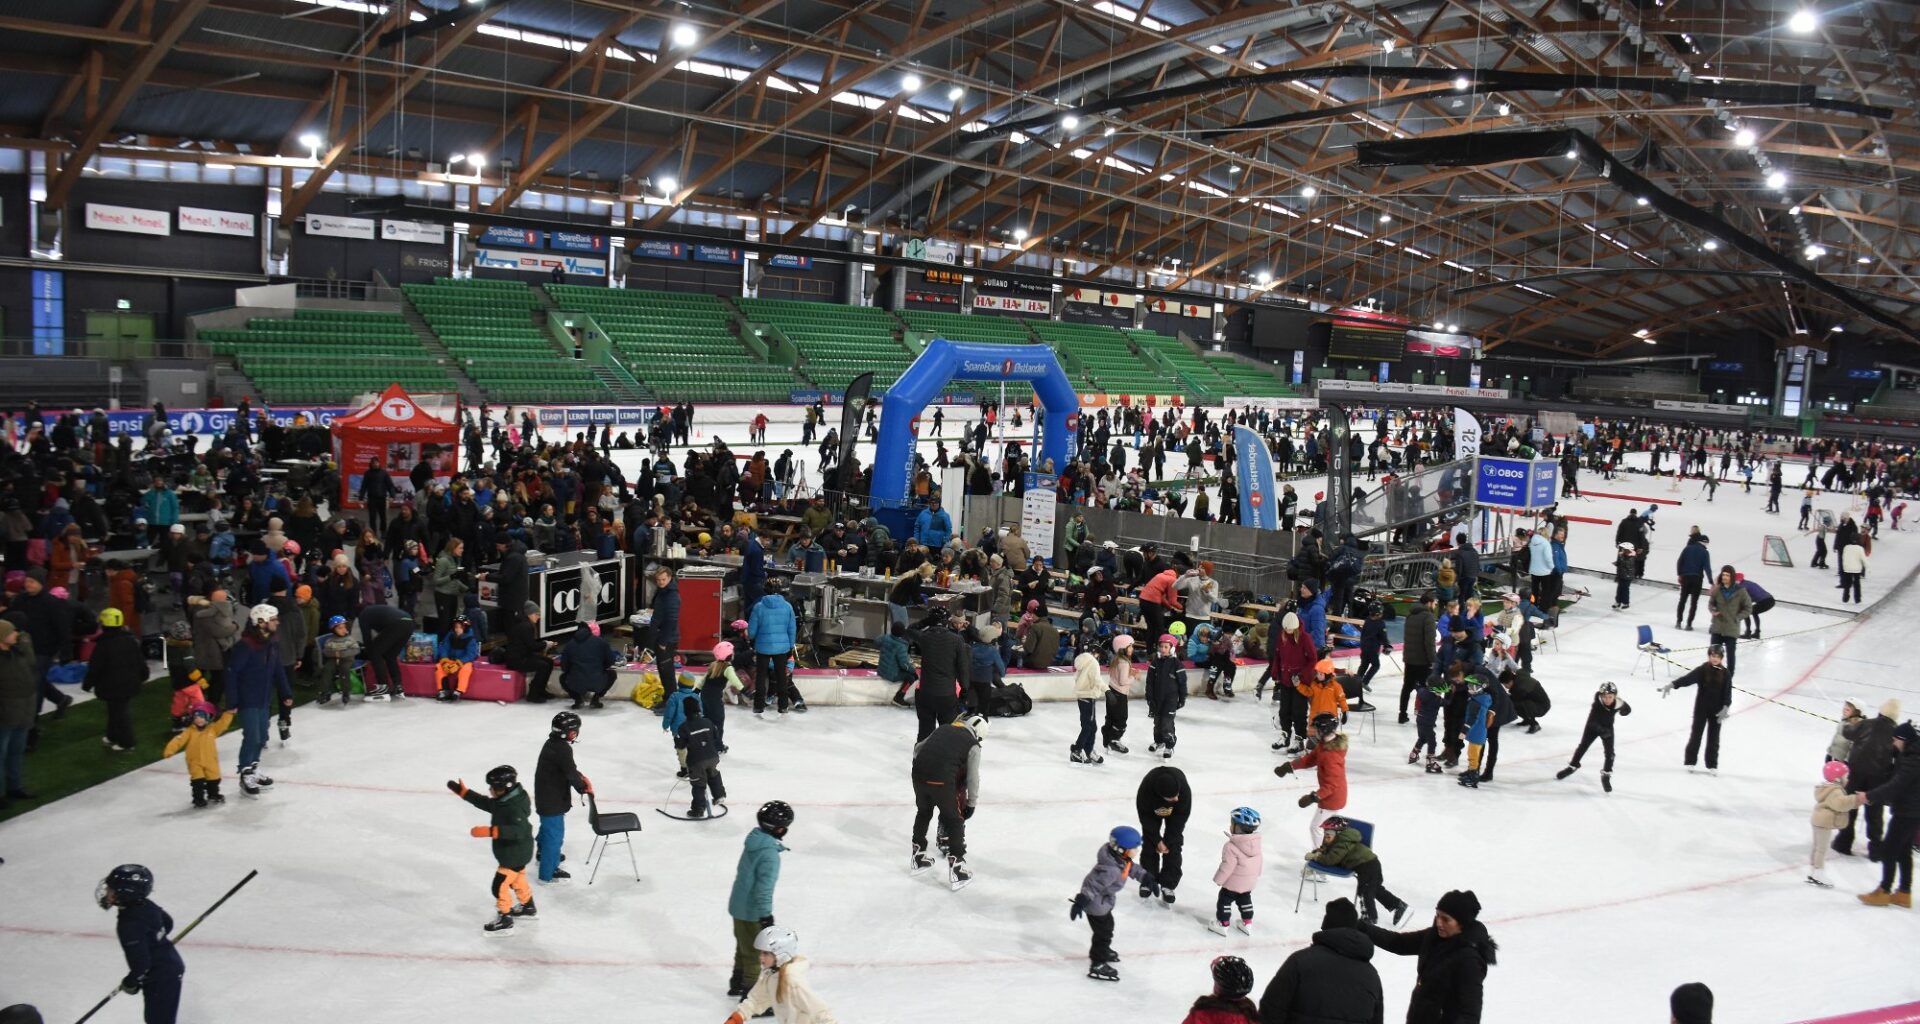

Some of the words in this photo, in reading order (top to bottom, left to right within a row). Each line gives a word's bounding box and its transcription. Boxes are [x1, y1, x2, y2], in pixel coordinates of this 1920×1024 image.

[488, 226, 524, 238] SpareBank
[558, 232, 591, 244] SpareBank
[700, 245, 729, 256] SpareBank
[964, 360, 1002, 372] SpareBank
[1014, 362, 1046, 372] Østlandet
[389, 404, 406, 416] T
[542, 412, 562, 420] LERØY
[1497, 469, 1524, 479] OBOS
